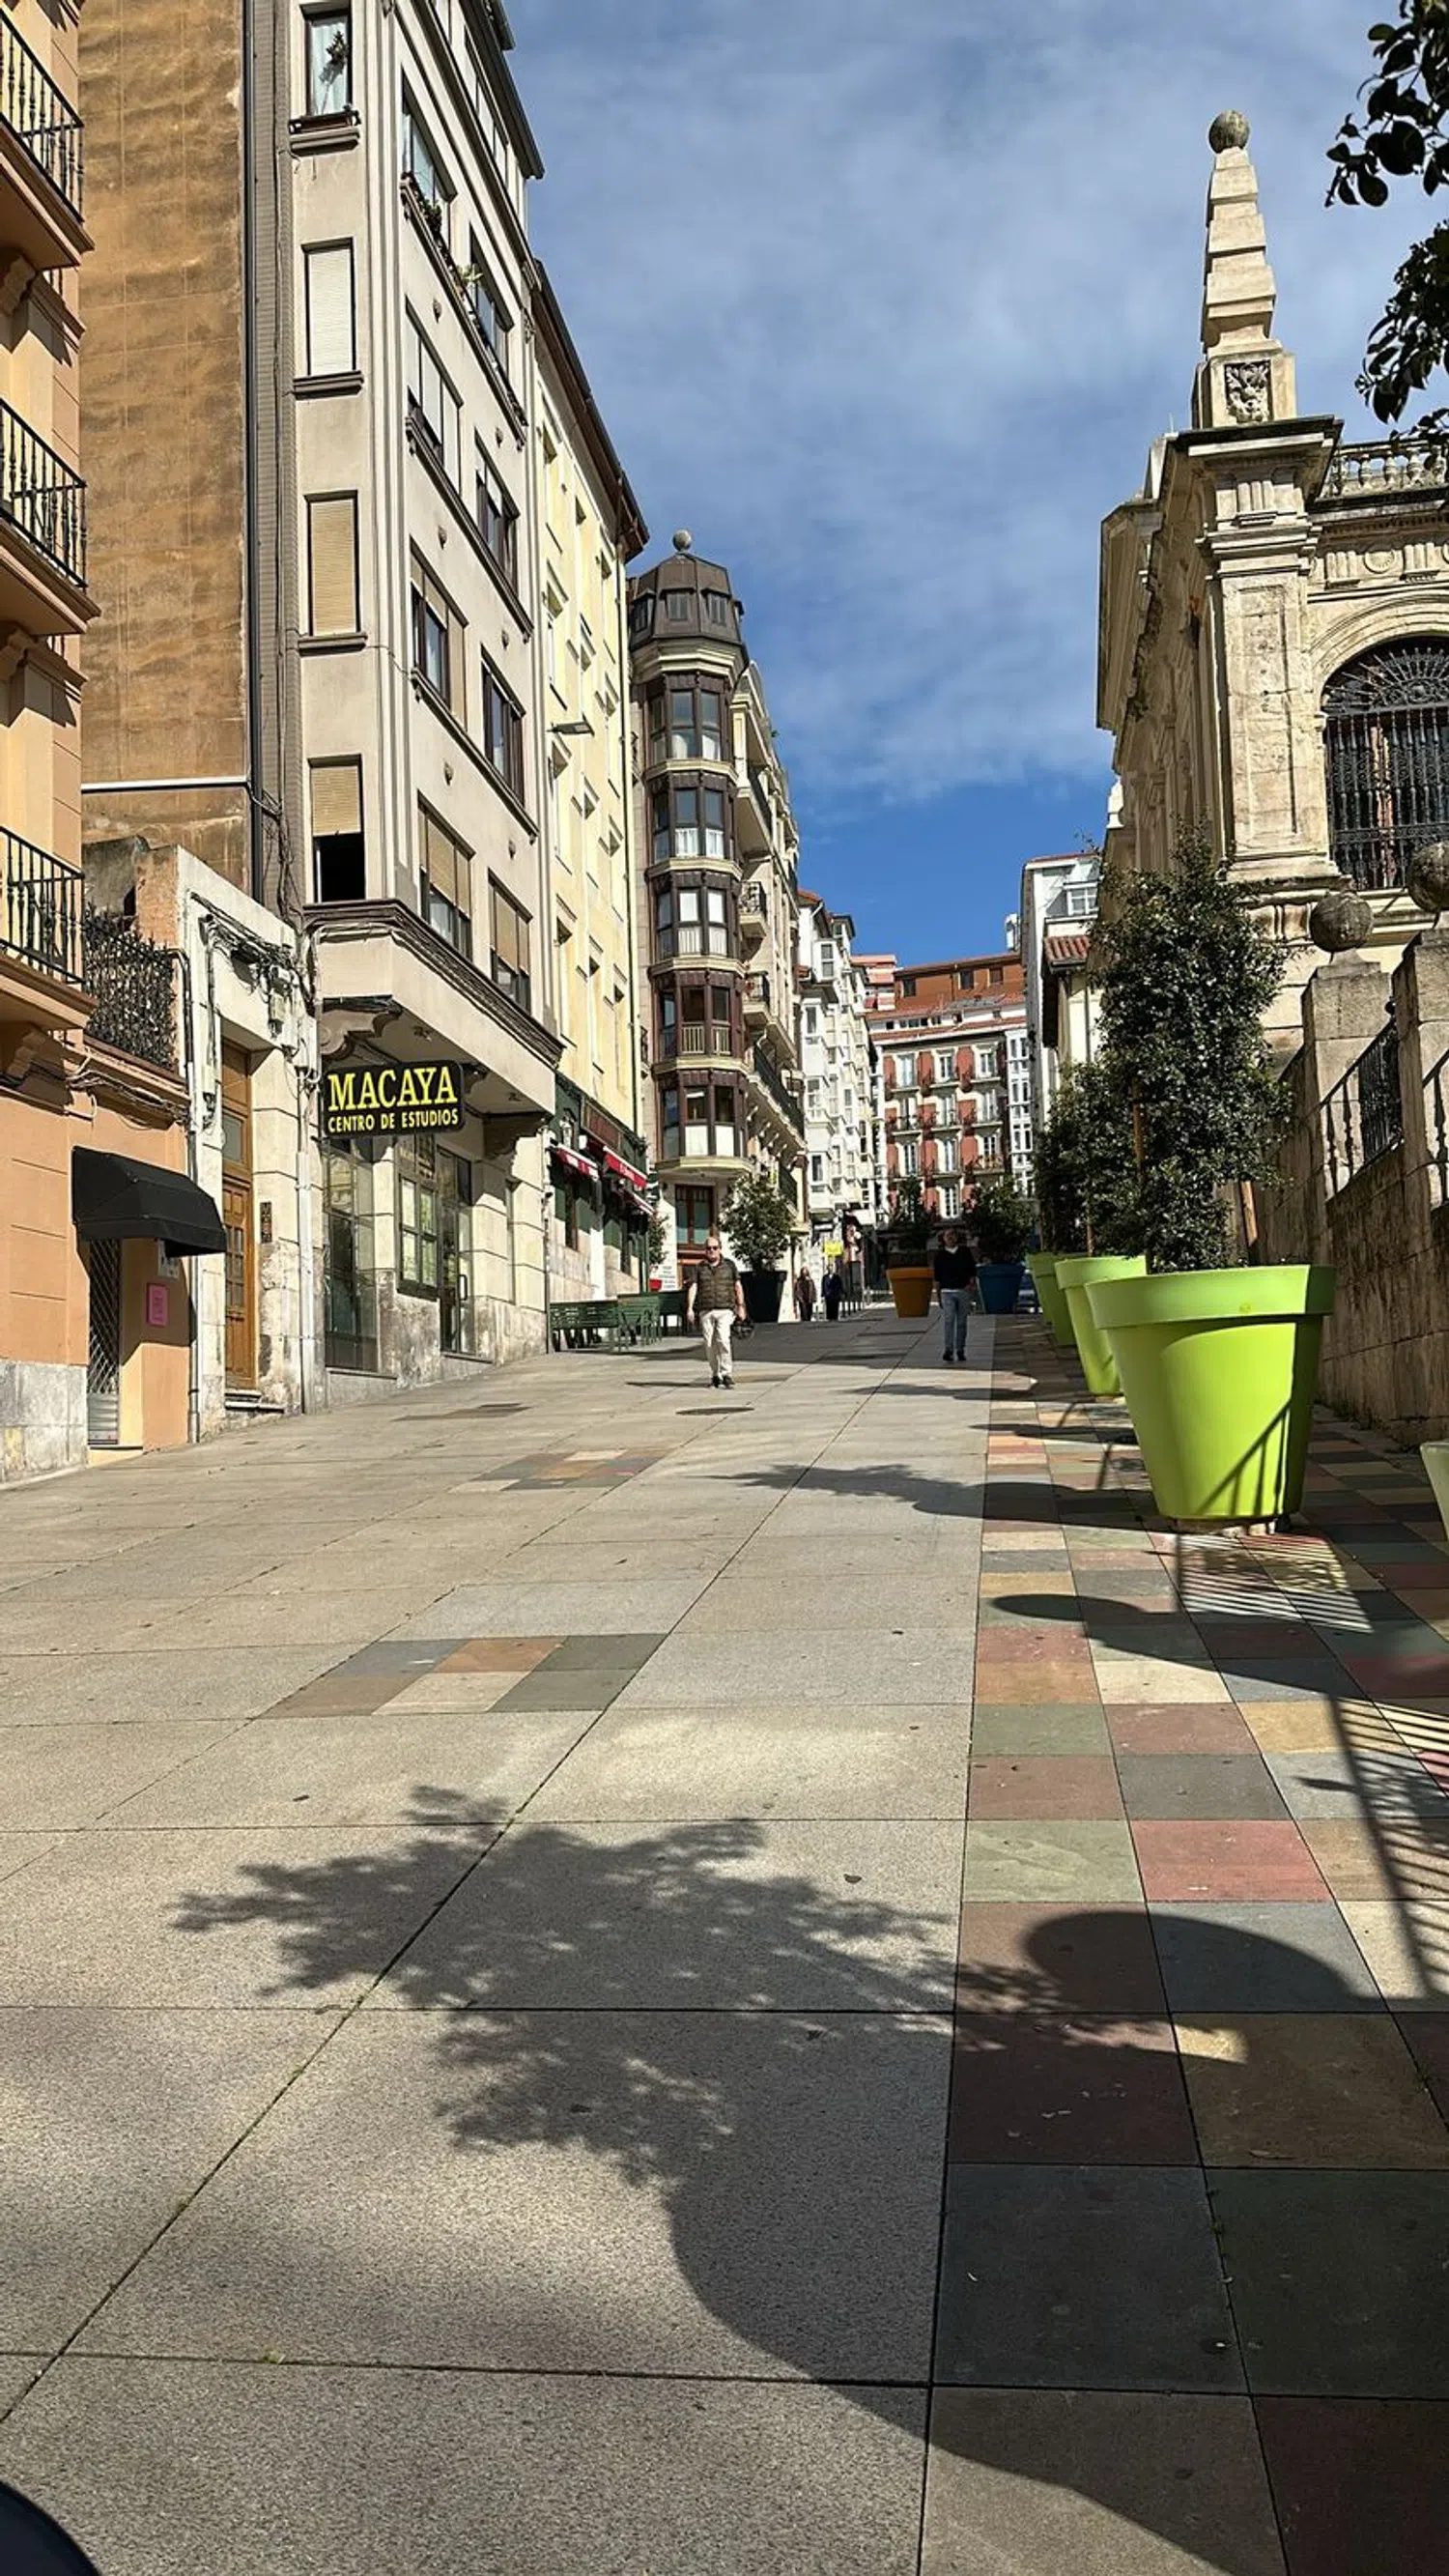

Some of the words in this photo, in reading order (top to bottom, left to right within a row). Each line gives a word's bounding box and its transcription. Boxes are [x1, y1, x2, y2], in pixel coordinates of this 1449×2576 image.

[327, 1066, 459, 1112] MACAYA
[327, 1114, 376, 1133] CENTRO
[381, 1112, 395, 1130] DE
[401, 1108, 459, 1129] ESTUDIOS
